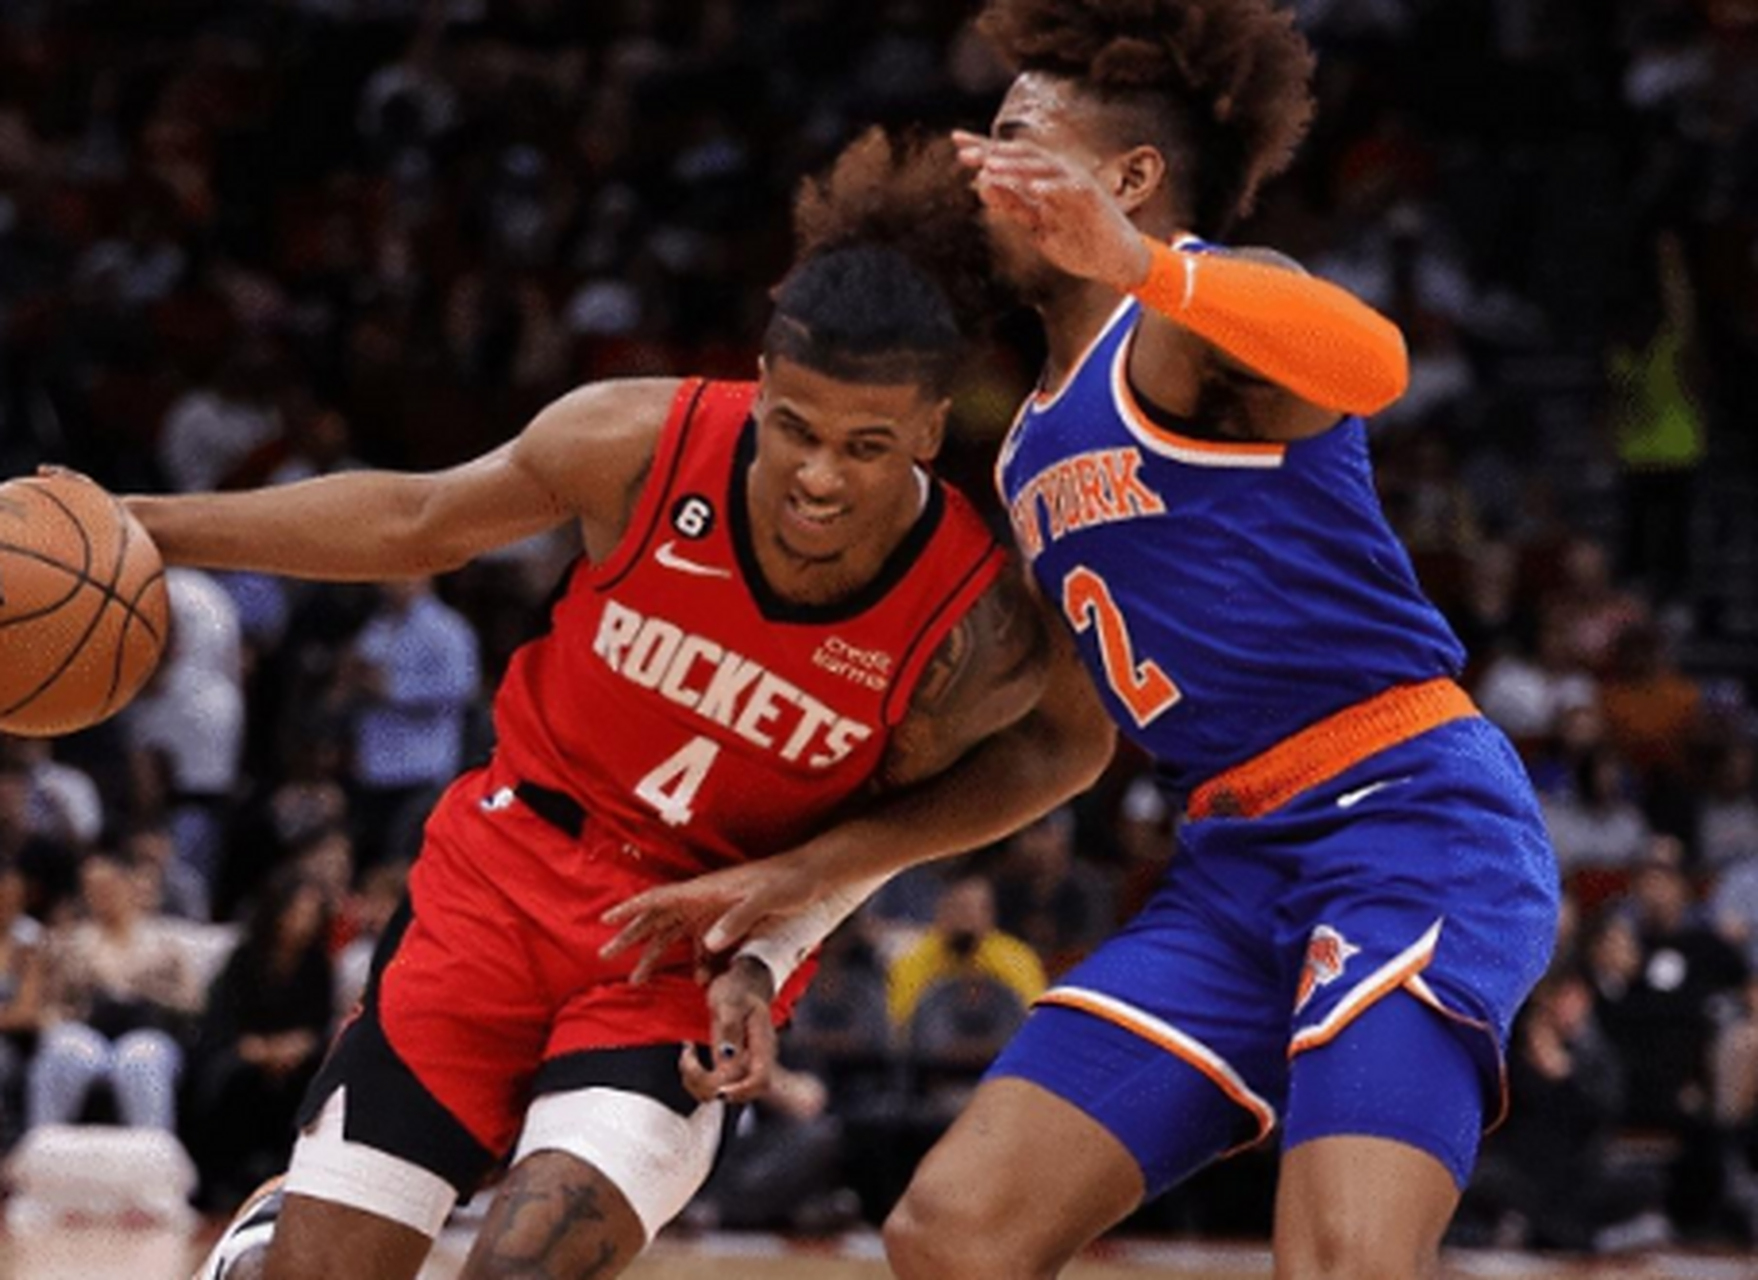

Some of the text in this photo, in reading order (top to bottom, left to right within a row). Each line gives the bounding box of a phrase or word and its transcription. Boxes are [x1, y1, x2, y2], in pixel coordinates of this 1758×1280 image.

[677, 501, 710, 535] 6
[592, 600, 872, 769] ROCKETS
[1063, 565, 1182, 729] 2
[634, 734, 721, 827] 4
